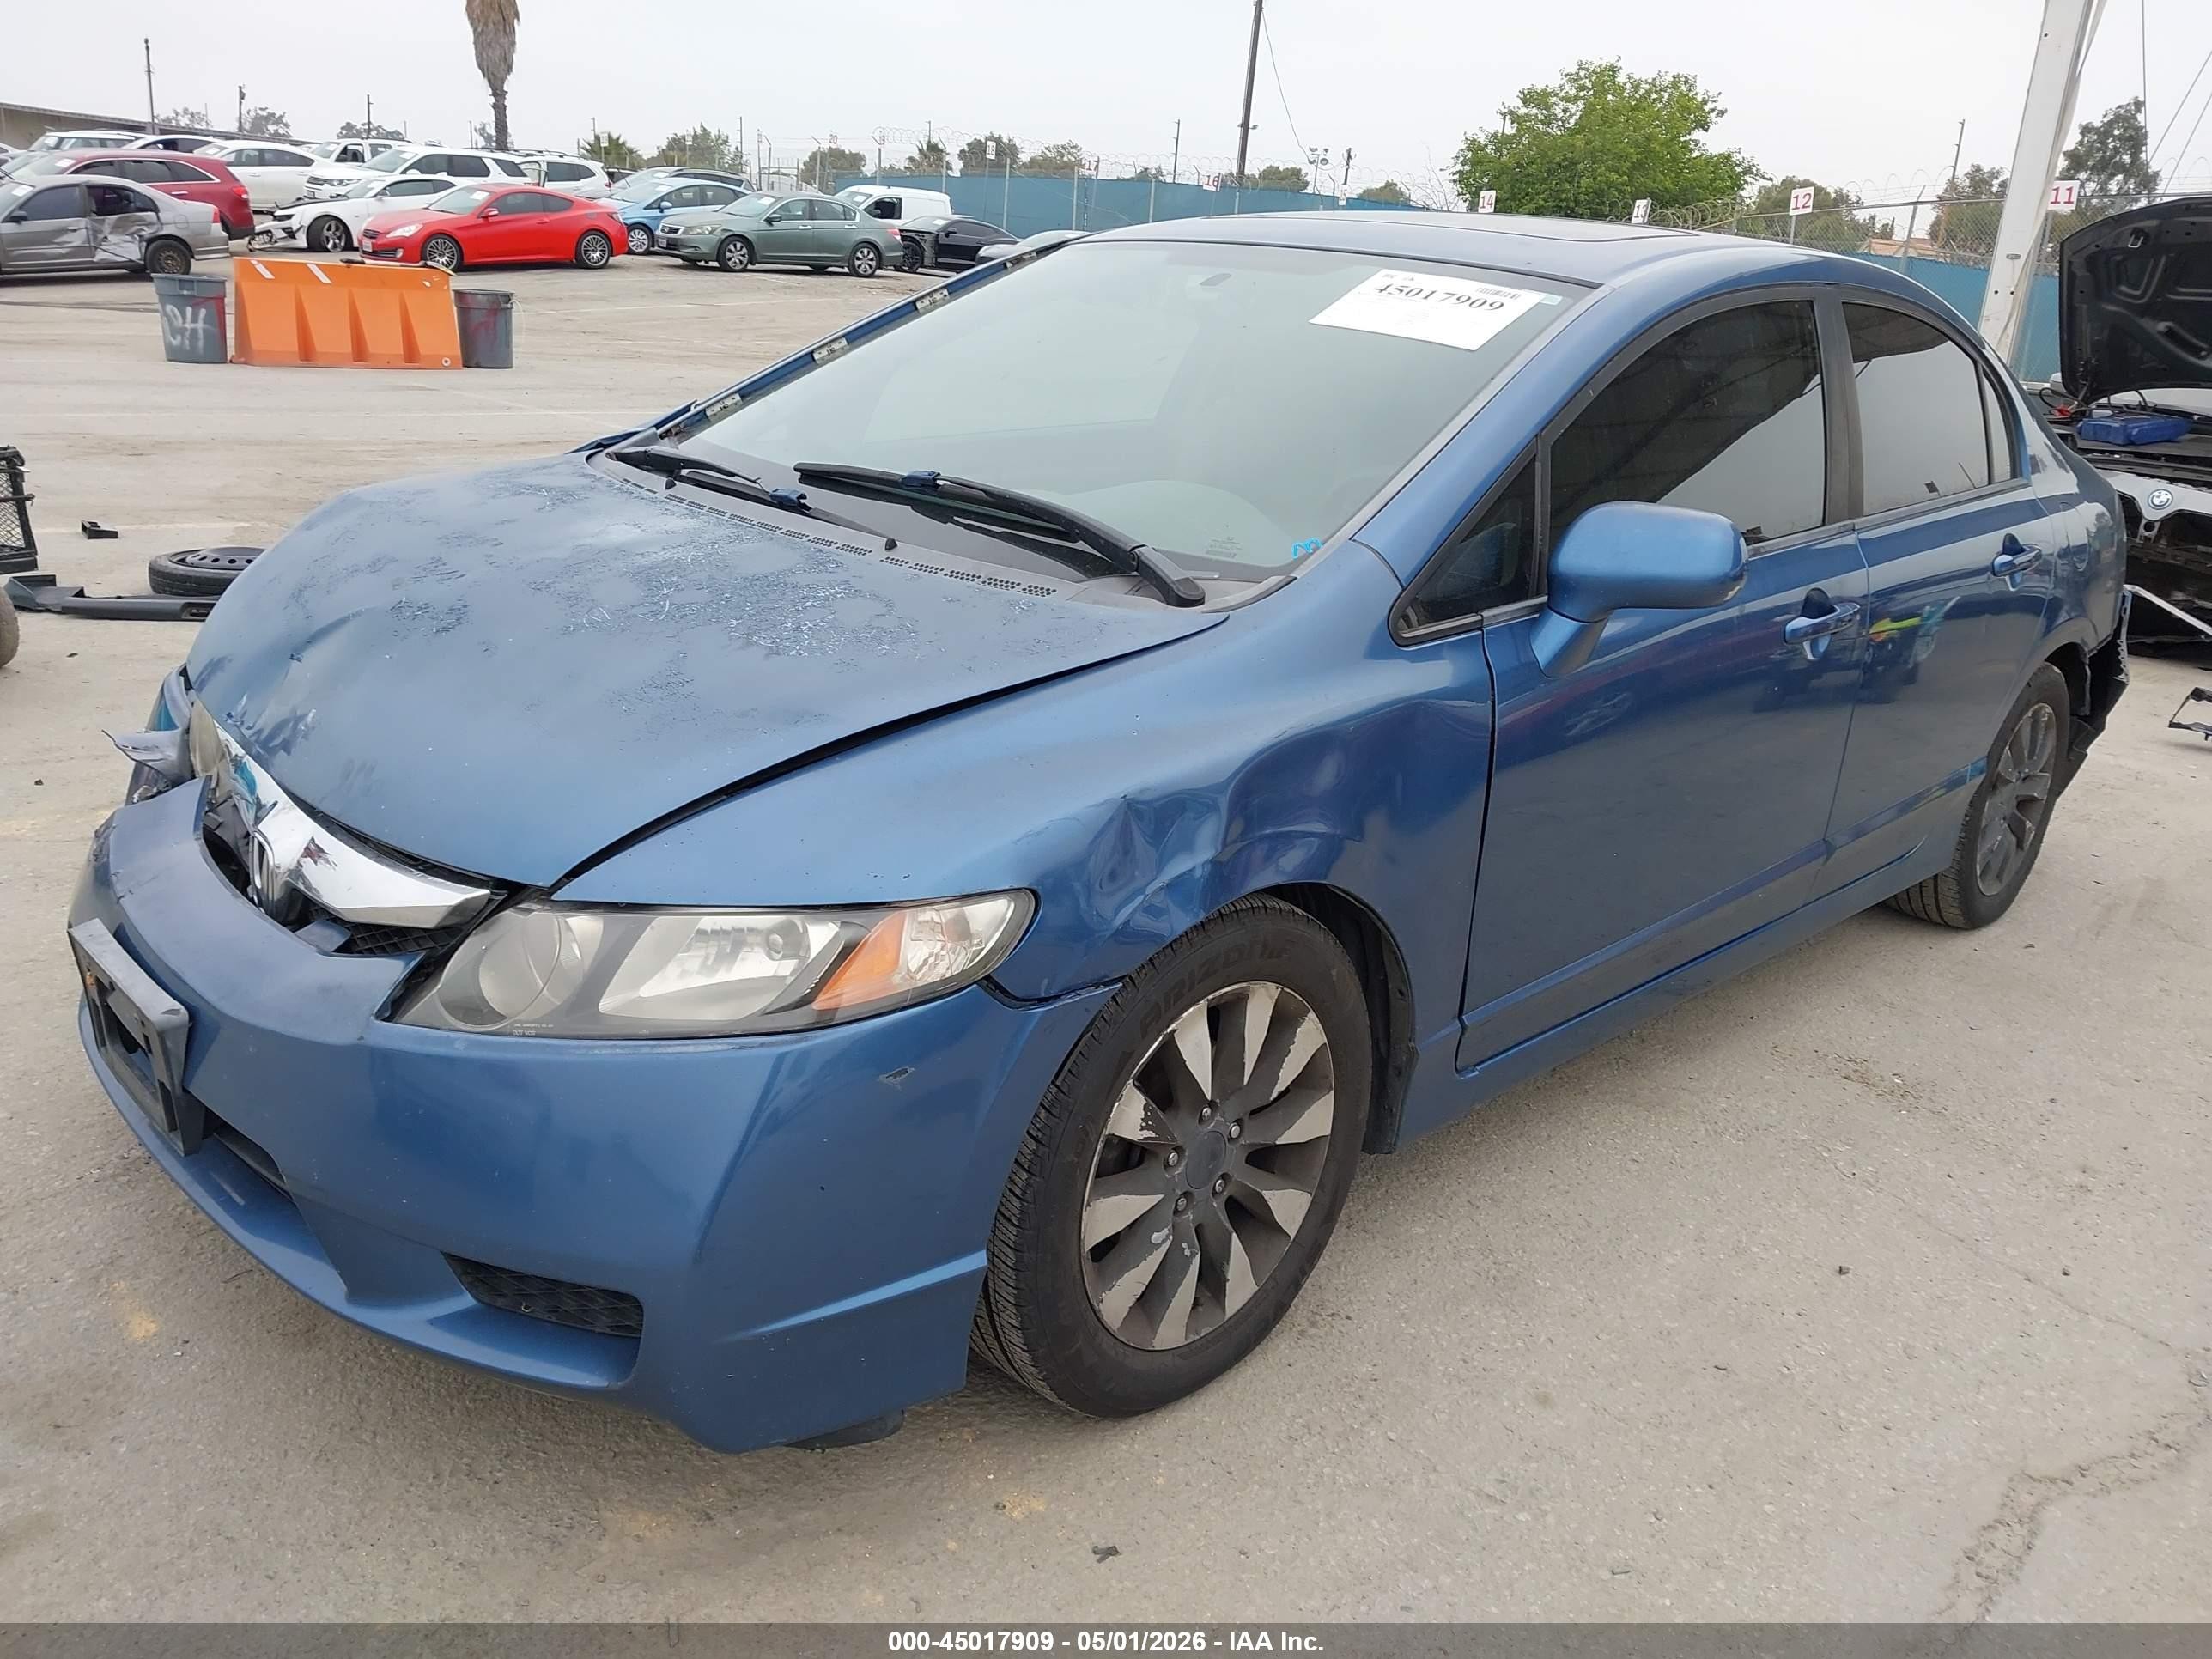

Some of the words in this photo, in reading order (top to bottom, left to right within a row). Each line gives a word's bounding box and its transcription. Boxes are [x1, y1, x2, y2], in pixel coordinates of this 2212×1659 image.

[1480, 194, 1493, 209] 14
[1791, 192, 1812, 210] 12
[2050, 186, 2075, 204] 11
[1373, 283, 1505, 311] 45017909
